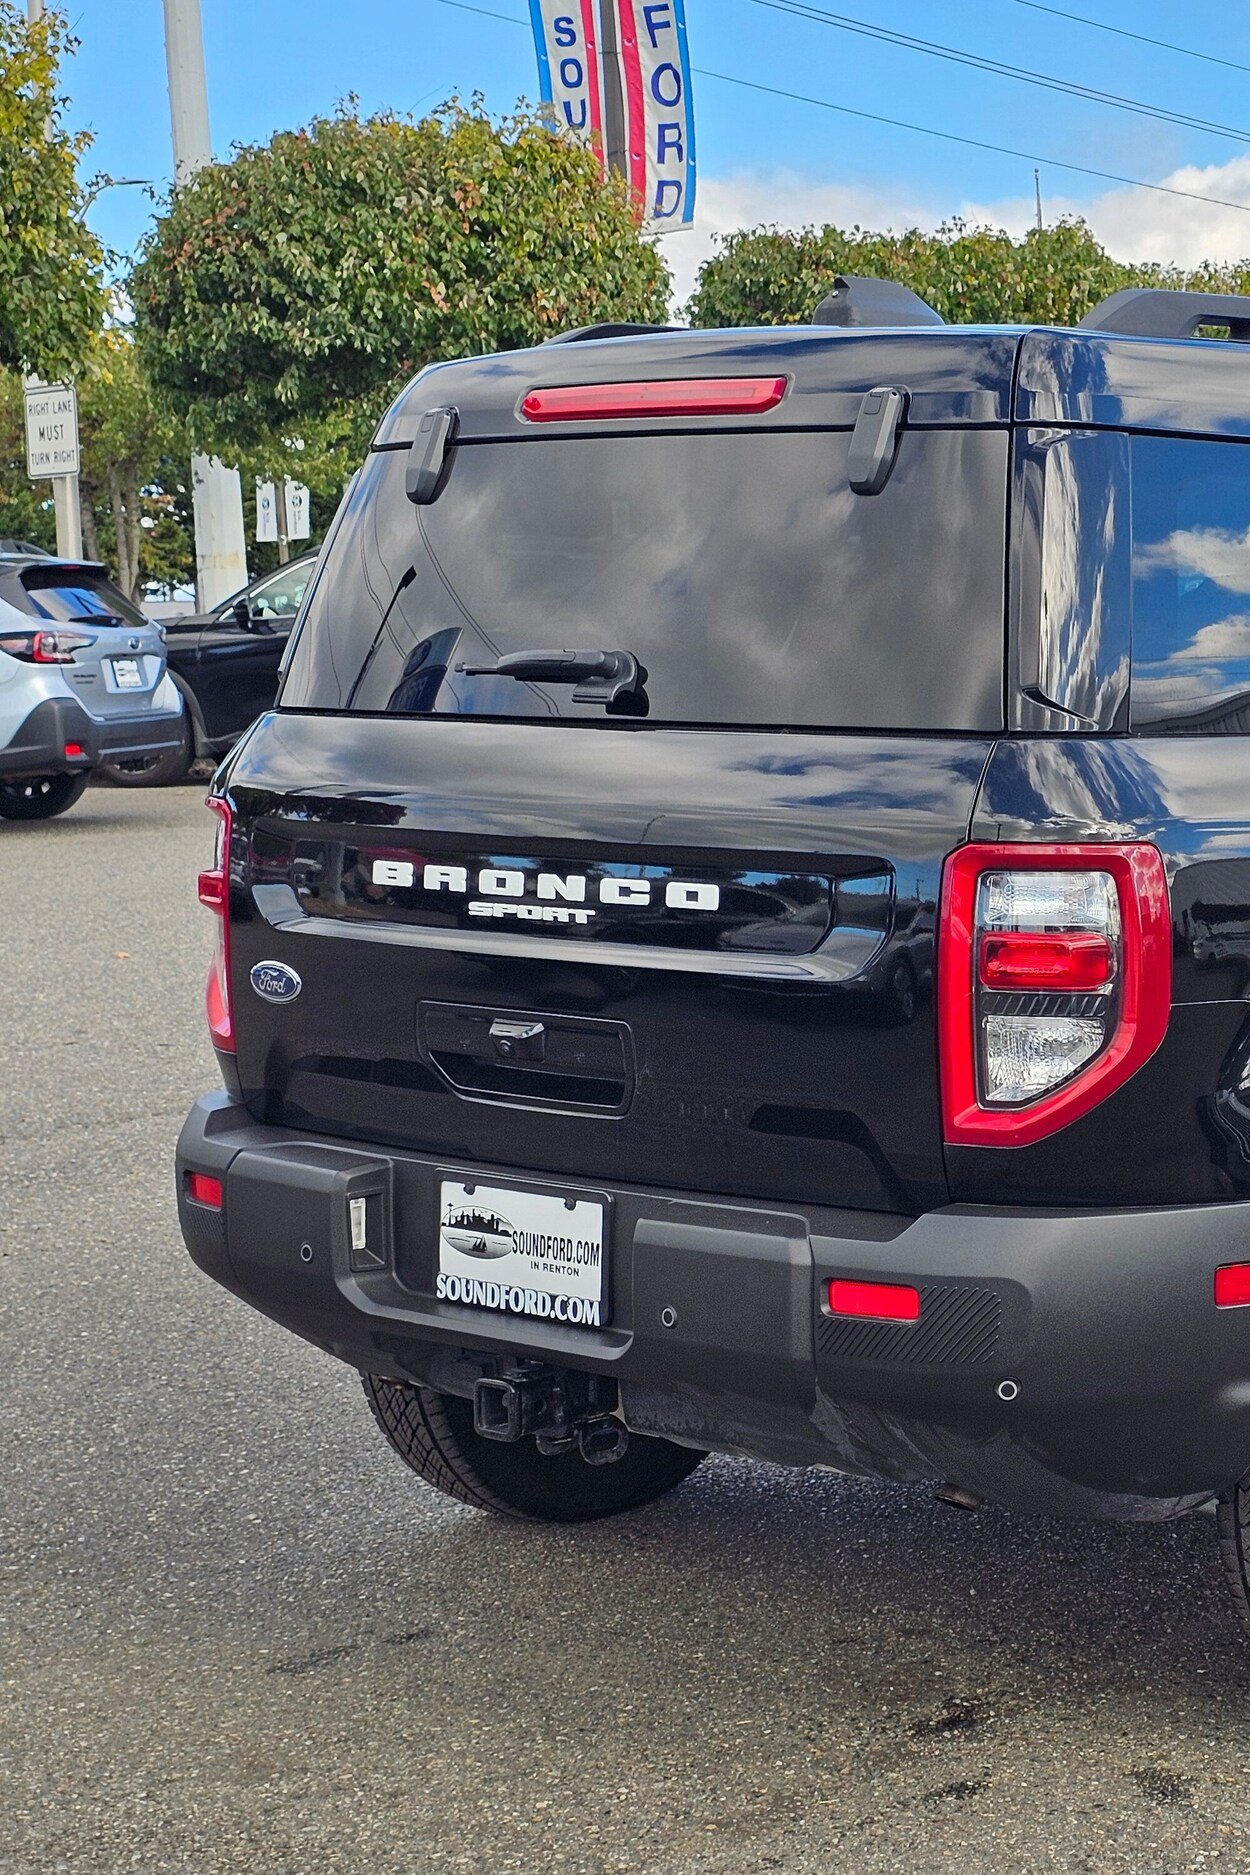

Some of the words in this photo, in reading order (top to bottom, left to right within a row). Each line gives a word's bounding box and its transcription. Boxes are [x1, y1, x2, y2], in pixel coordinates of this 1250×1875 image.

[553, 16, 587, 130] SOU
[643, 4, 683, 219] FORD
[28, 402, 49, 416] RIGHT
[52, 400, 72, 415] LANE
[38, 424, 64, 441] MUST
[31, 452, 50, 466] TURN
[53, 449, 75, 463] RIGHT
[372, 859, 720, 911] BRONCO
[468, 901, 597, 925] SPORT
[258, 968, 287, 994] Ford
[512, 1230, 600, 1267] SOUNDFORD.COM
[530, 1261, 539, 1271] IN
[543, 1262, 580, 1277] RENTON
[436, 1272, 601, 1327] SOUNDFORD.COM
